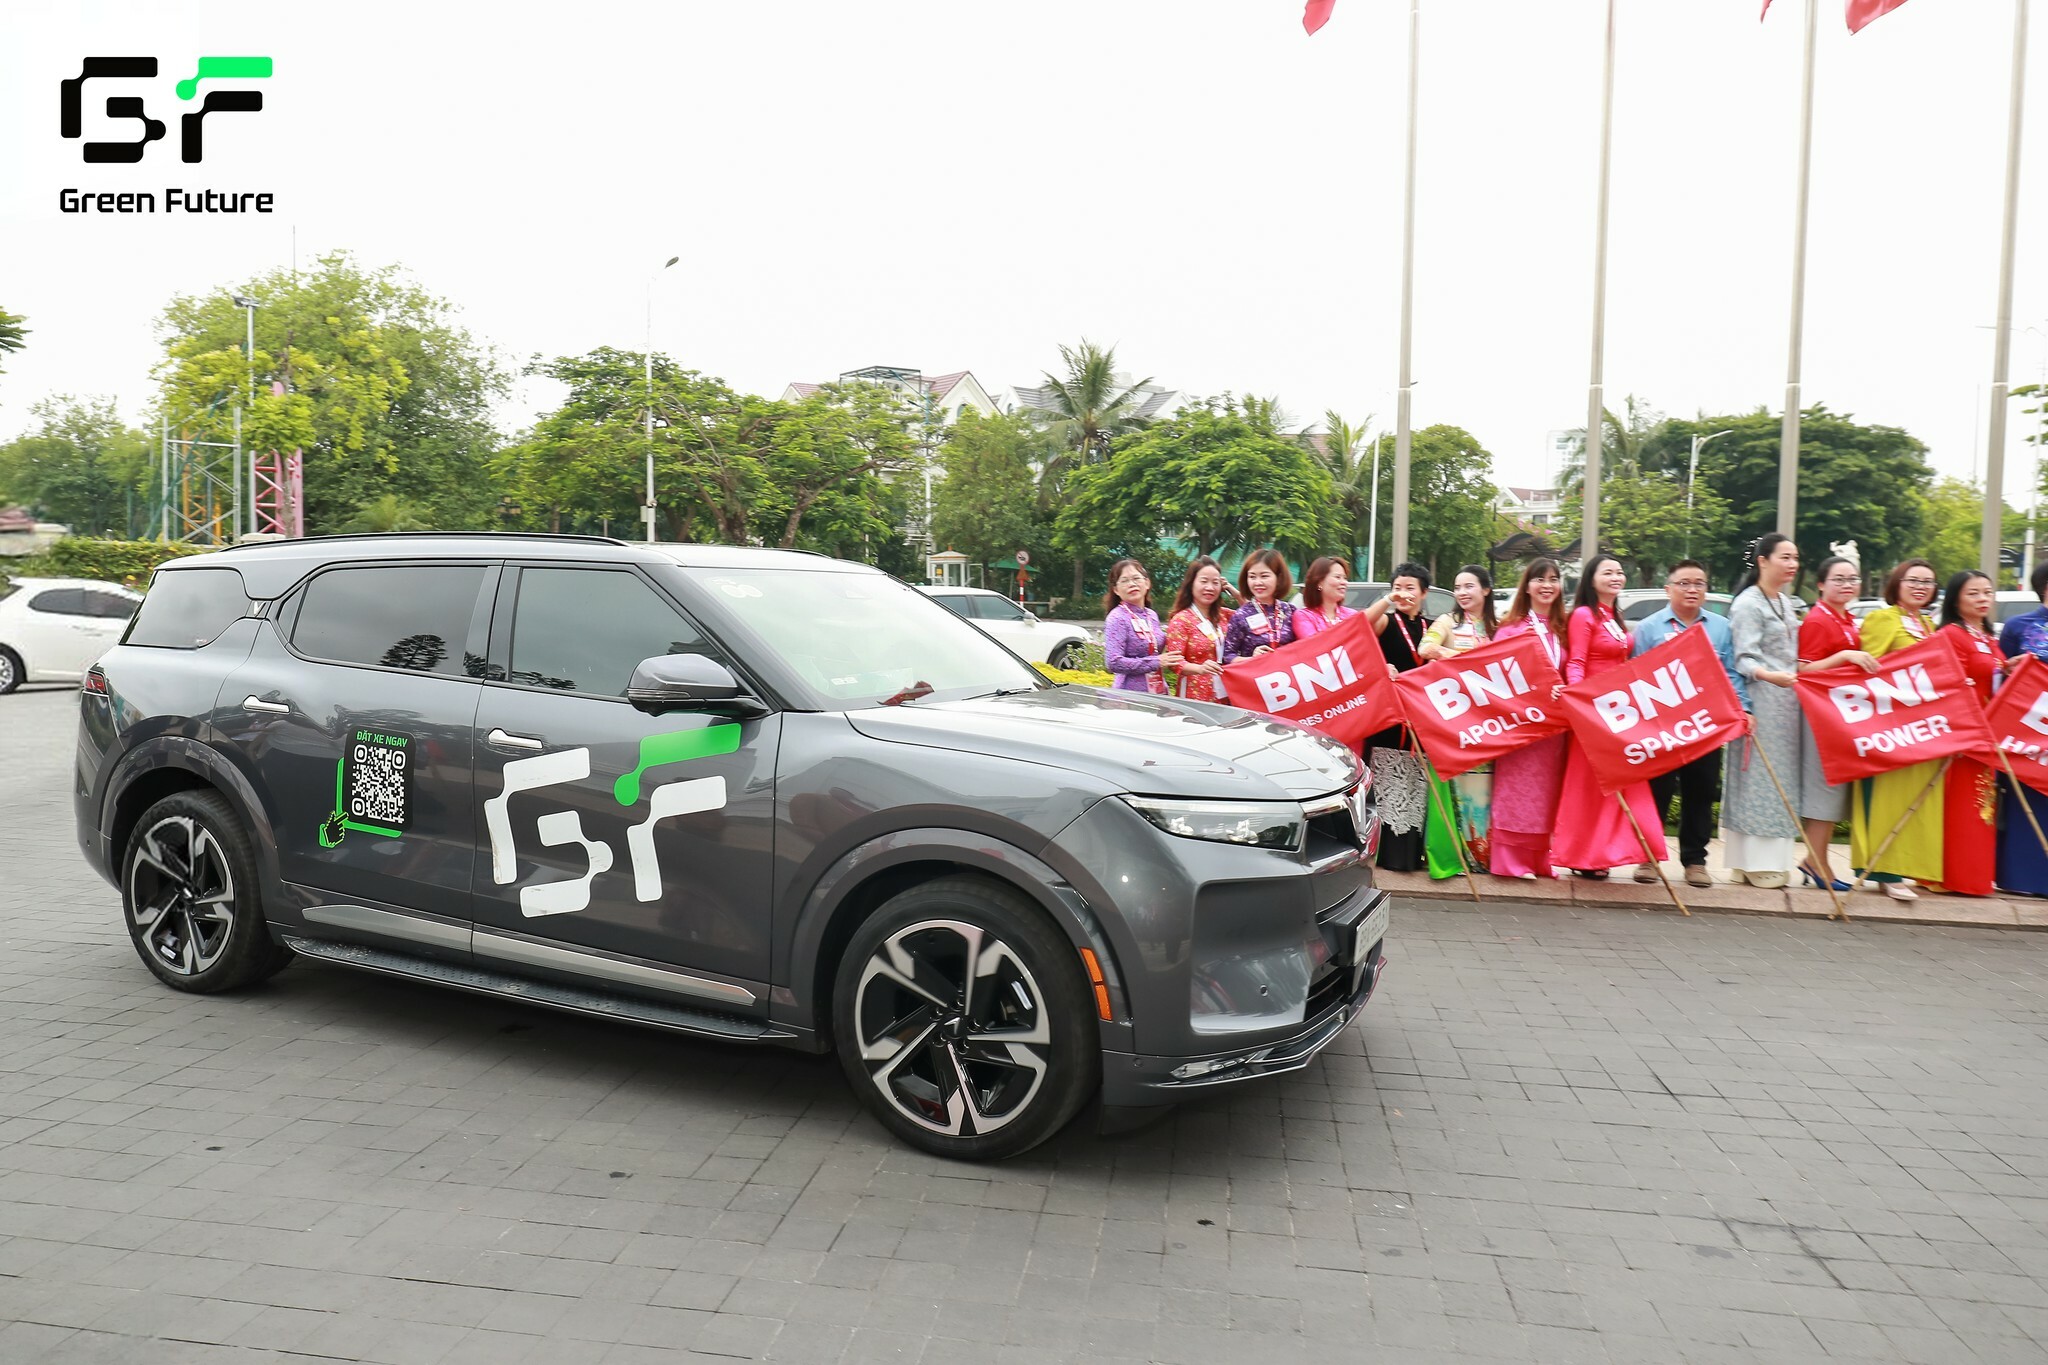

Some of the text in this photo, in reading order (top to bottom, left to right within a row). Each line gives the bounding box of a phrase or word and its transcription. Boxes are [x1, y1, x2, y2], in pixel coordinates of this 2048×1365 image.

[1254, 645, 1358, 713] BNI
[1323, 694, 1368, 719] ONLINE
[1424, 656, 1531, 721] BNI
[1592, 658, 1699, 734] BNI
[1828, 663, 1940, 724] BNI
[356, 730, 408, 748] ĐẶT XE NGAY
[1458, 706, 1546, 749] APOLLO
[1623, 709, 1718, 765] SPACE
[1853, 714, 1952, 757] POWER
